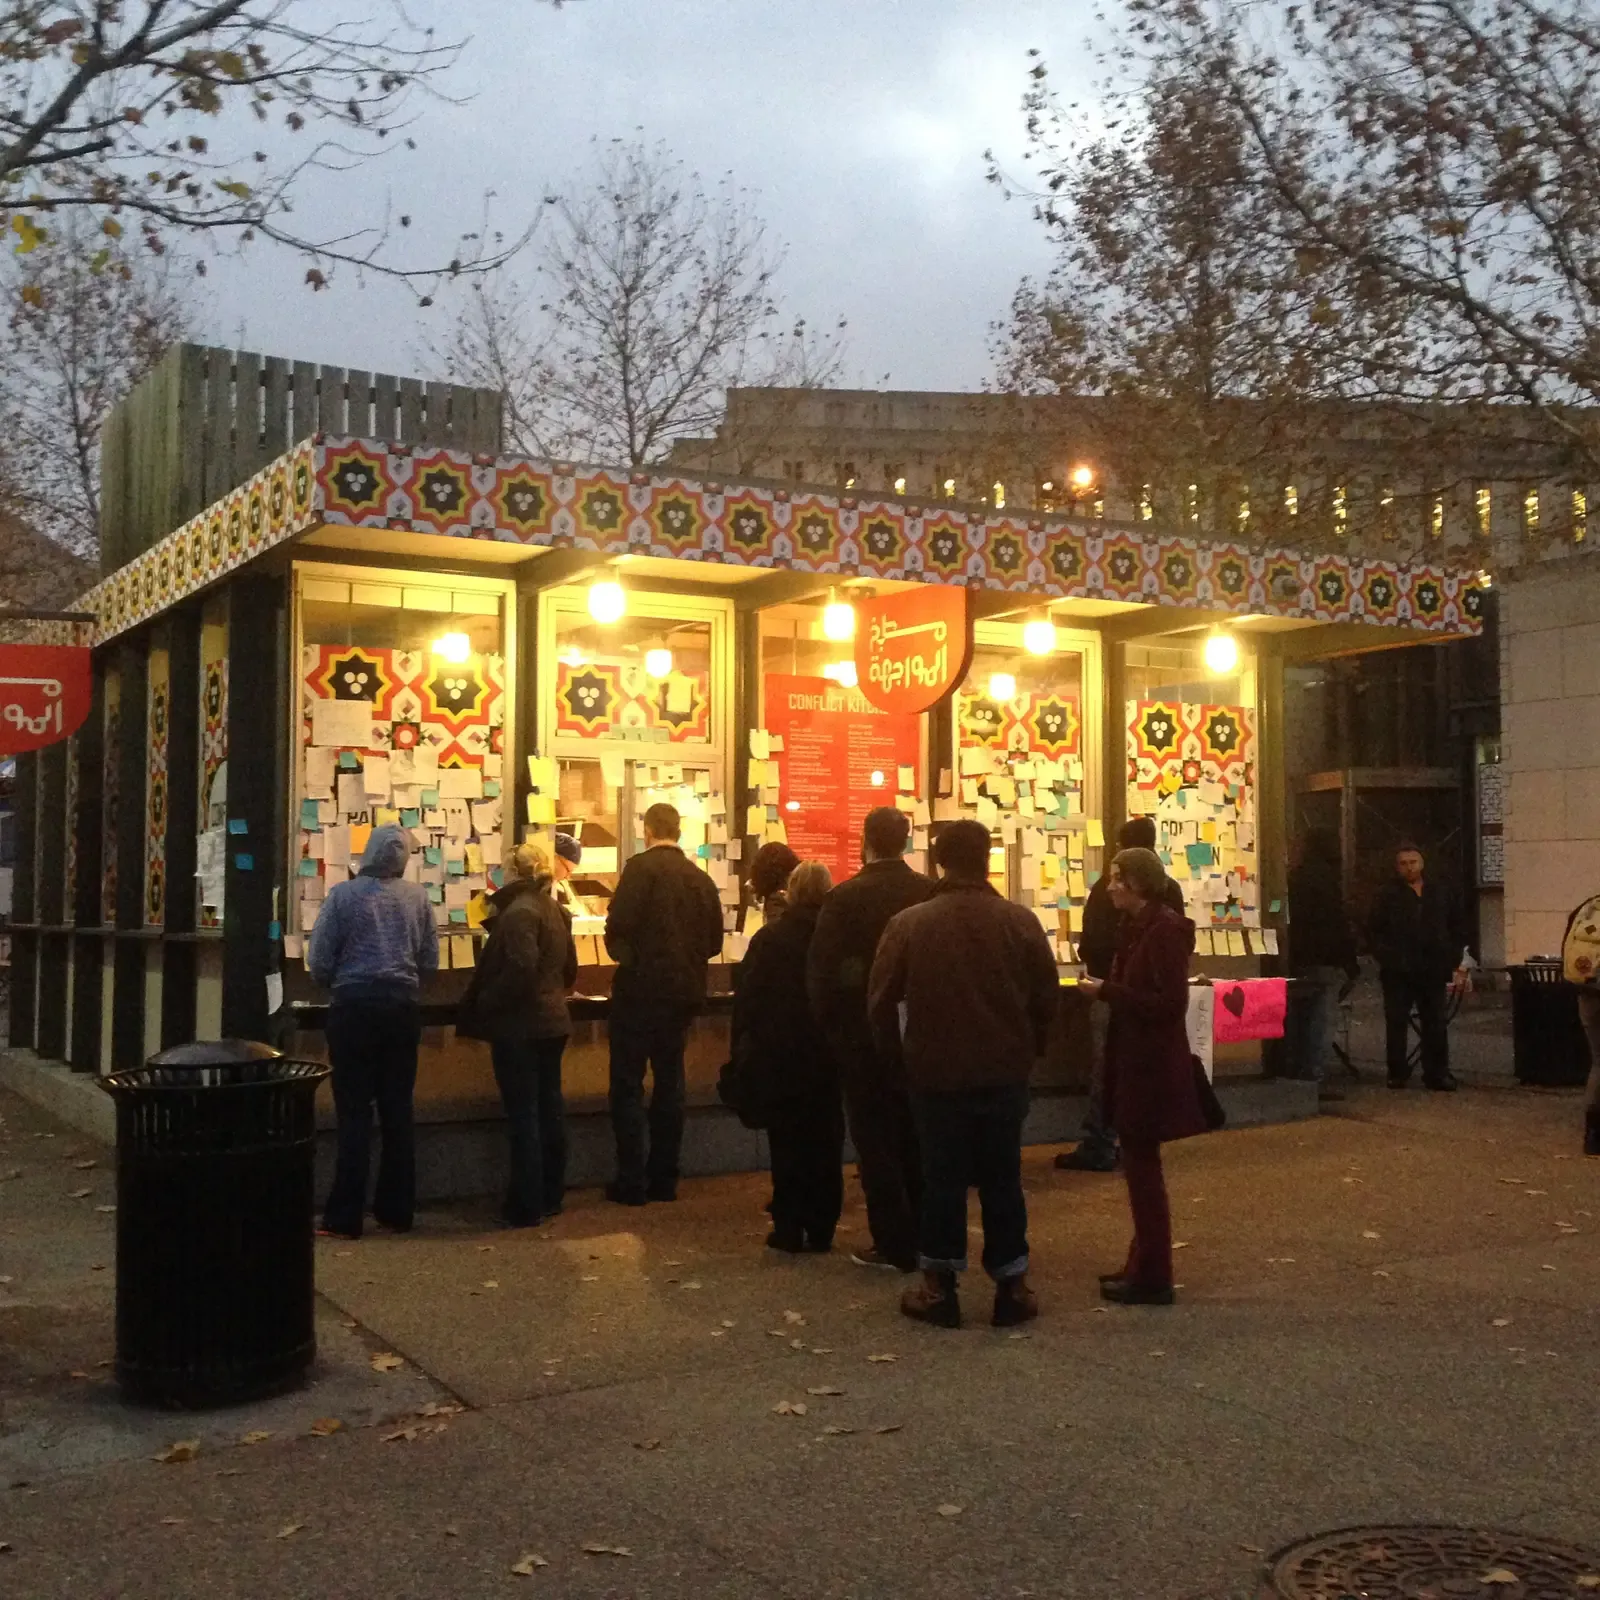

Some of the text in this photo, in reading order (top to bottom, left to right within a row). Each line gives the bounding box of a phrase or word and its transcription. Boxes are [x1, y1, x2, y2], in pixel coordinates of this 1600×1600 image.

[868, 612, 947, 653] مطبخ
[868, 642, 947, 693] المواجهة
[788, 693, 845, 713] CONFLICT
